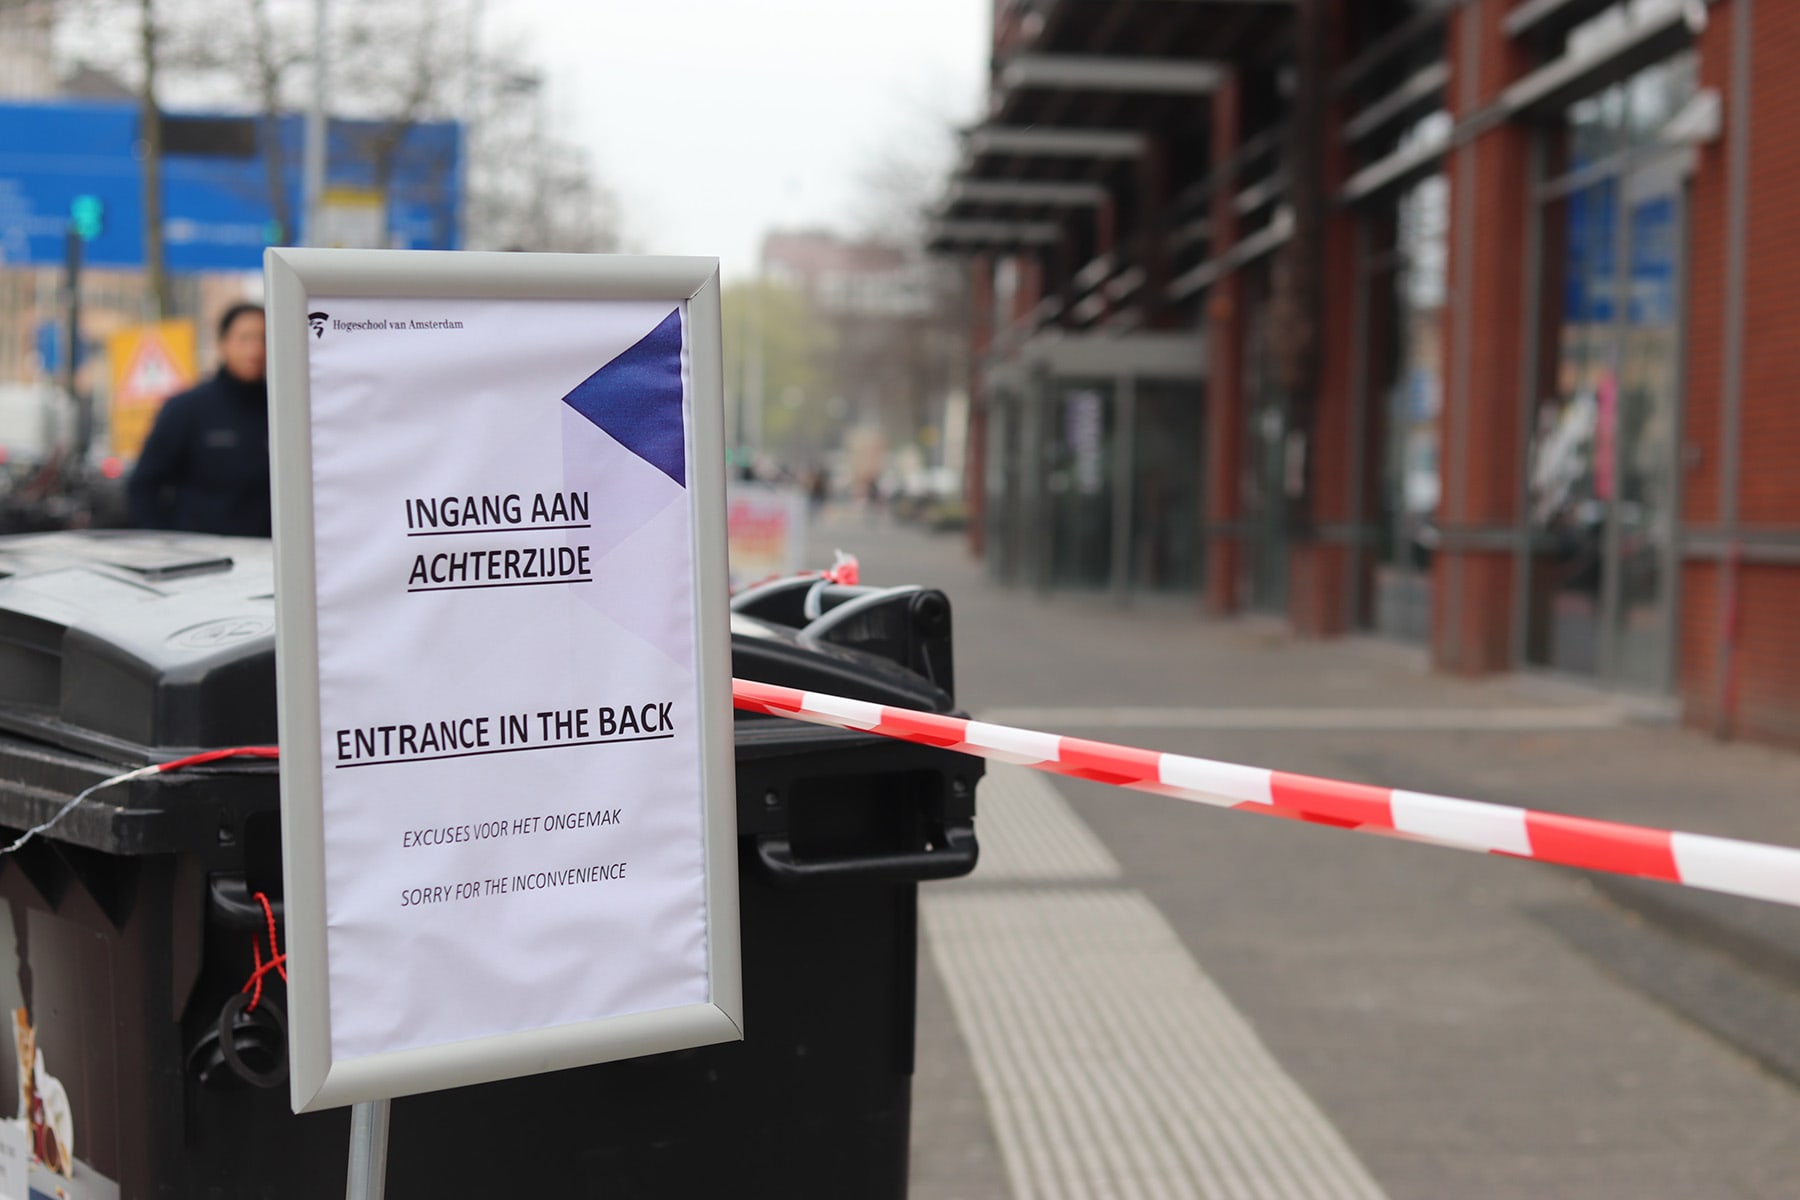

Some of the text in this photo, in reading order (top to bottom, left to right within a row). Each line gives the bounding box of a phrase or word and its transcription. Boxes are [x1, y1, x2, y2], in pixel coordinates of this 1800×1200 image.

[333, 319, 464, 332] Hogeschool van Amsterdam
[405, 491, 589, 529] INGANG AAN
[408, 546, 592, 585] ACHTERZIJDE
[336, 701, 674, 760] ENTRANCE IN THE BACK
[402, 808, 622, 848] EXCUSES VOOR HET ONGEMAK
[400, 862, 628, 907] SORRY FOR THE INCONVENIENCE
